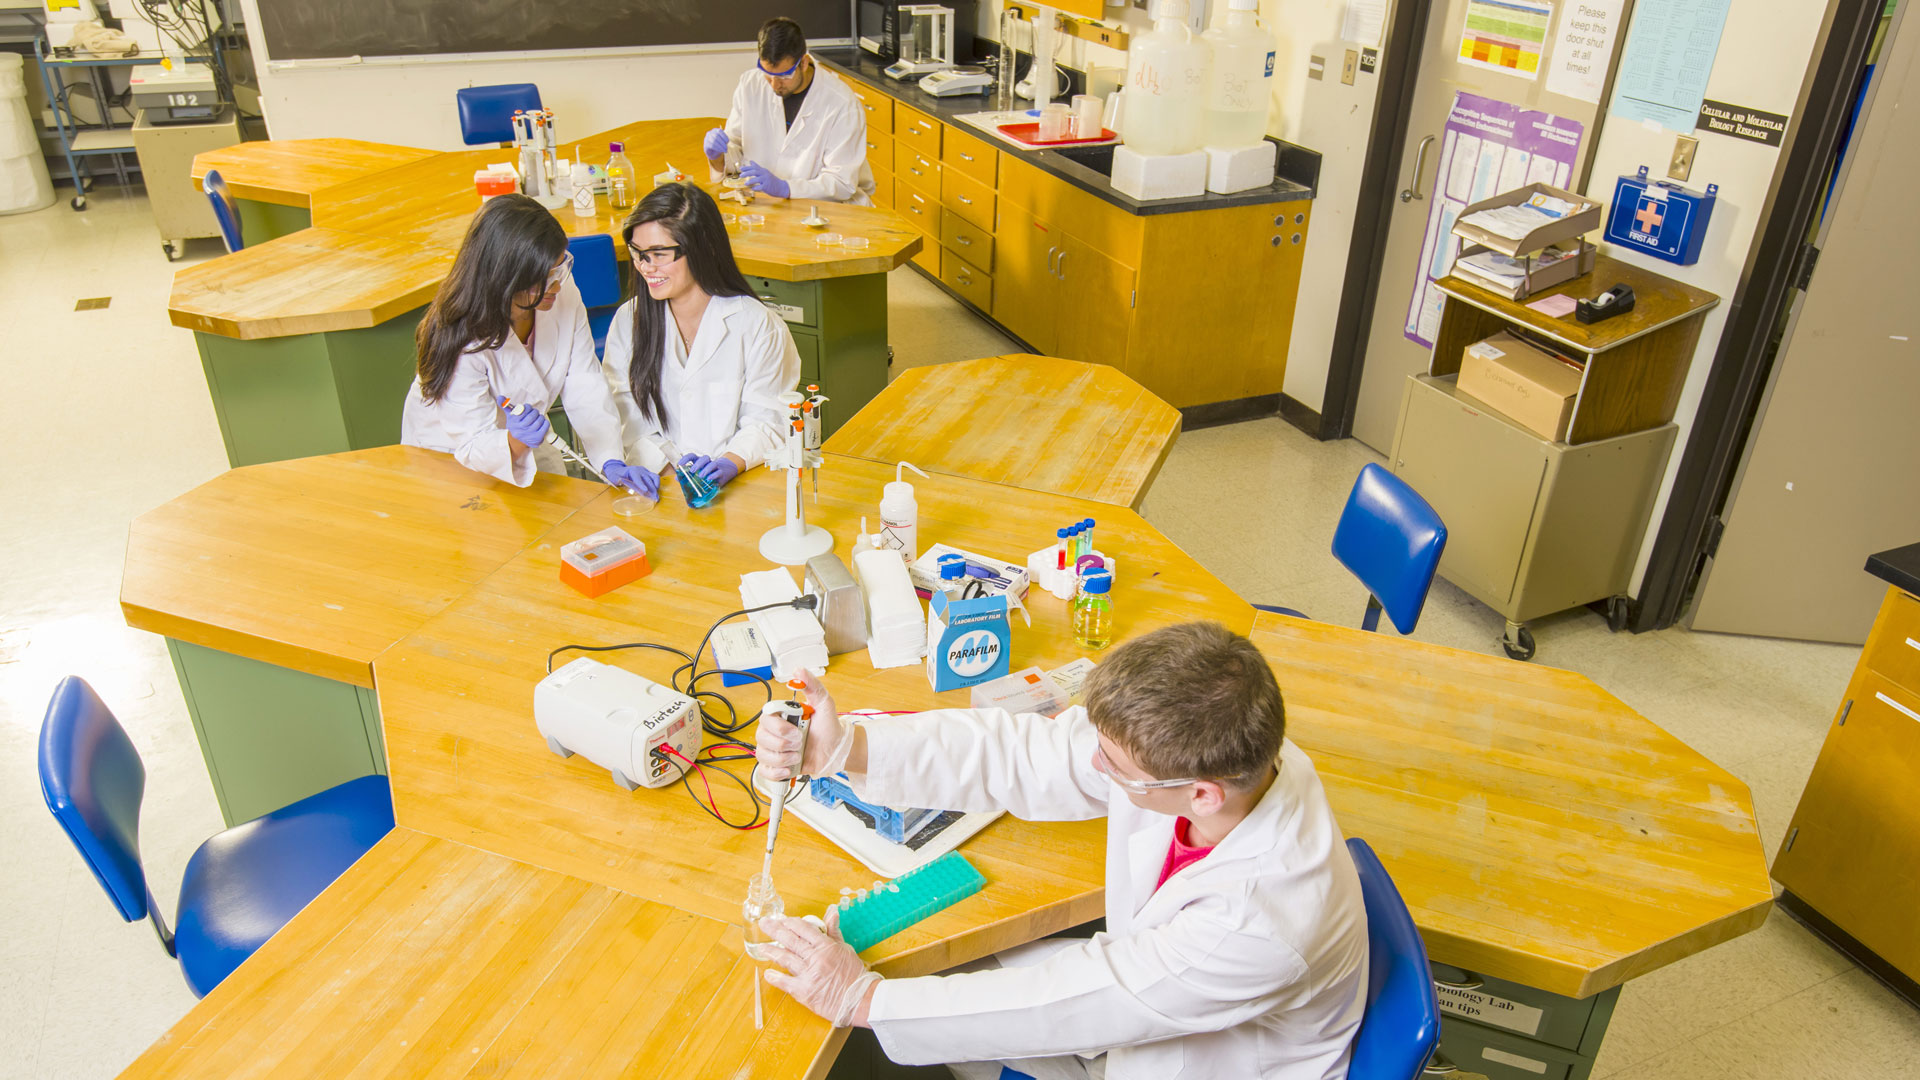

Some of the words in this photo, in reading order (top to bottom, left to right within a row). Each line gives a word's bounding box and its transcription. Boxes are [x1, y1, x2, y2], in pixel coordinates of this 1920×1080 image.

[1578, 5, 1606, 19] Please
[1570, 19, 1590, 33] keep
[1592, 22, 1607, 34] this
[1566, 33, 1585, 44] door
[1586, 37, 1605, 48] shut
[1572, 50, 1580, 58] at
[1581, 51, 1592, 60] all
[1566, 62, 1591, 74] times!
[168, 94, 199, 106] 182
[1629, 231, 1647, 243] FIRST
[1645, 236, 1659, 247] AID
[949, 644, 998, 660] PARAFILM
[643, 700, 687, 729] Biotech
[1458, 1003, 1481, 1015] tips
[1489, 997, 1515, 1011] Lab
